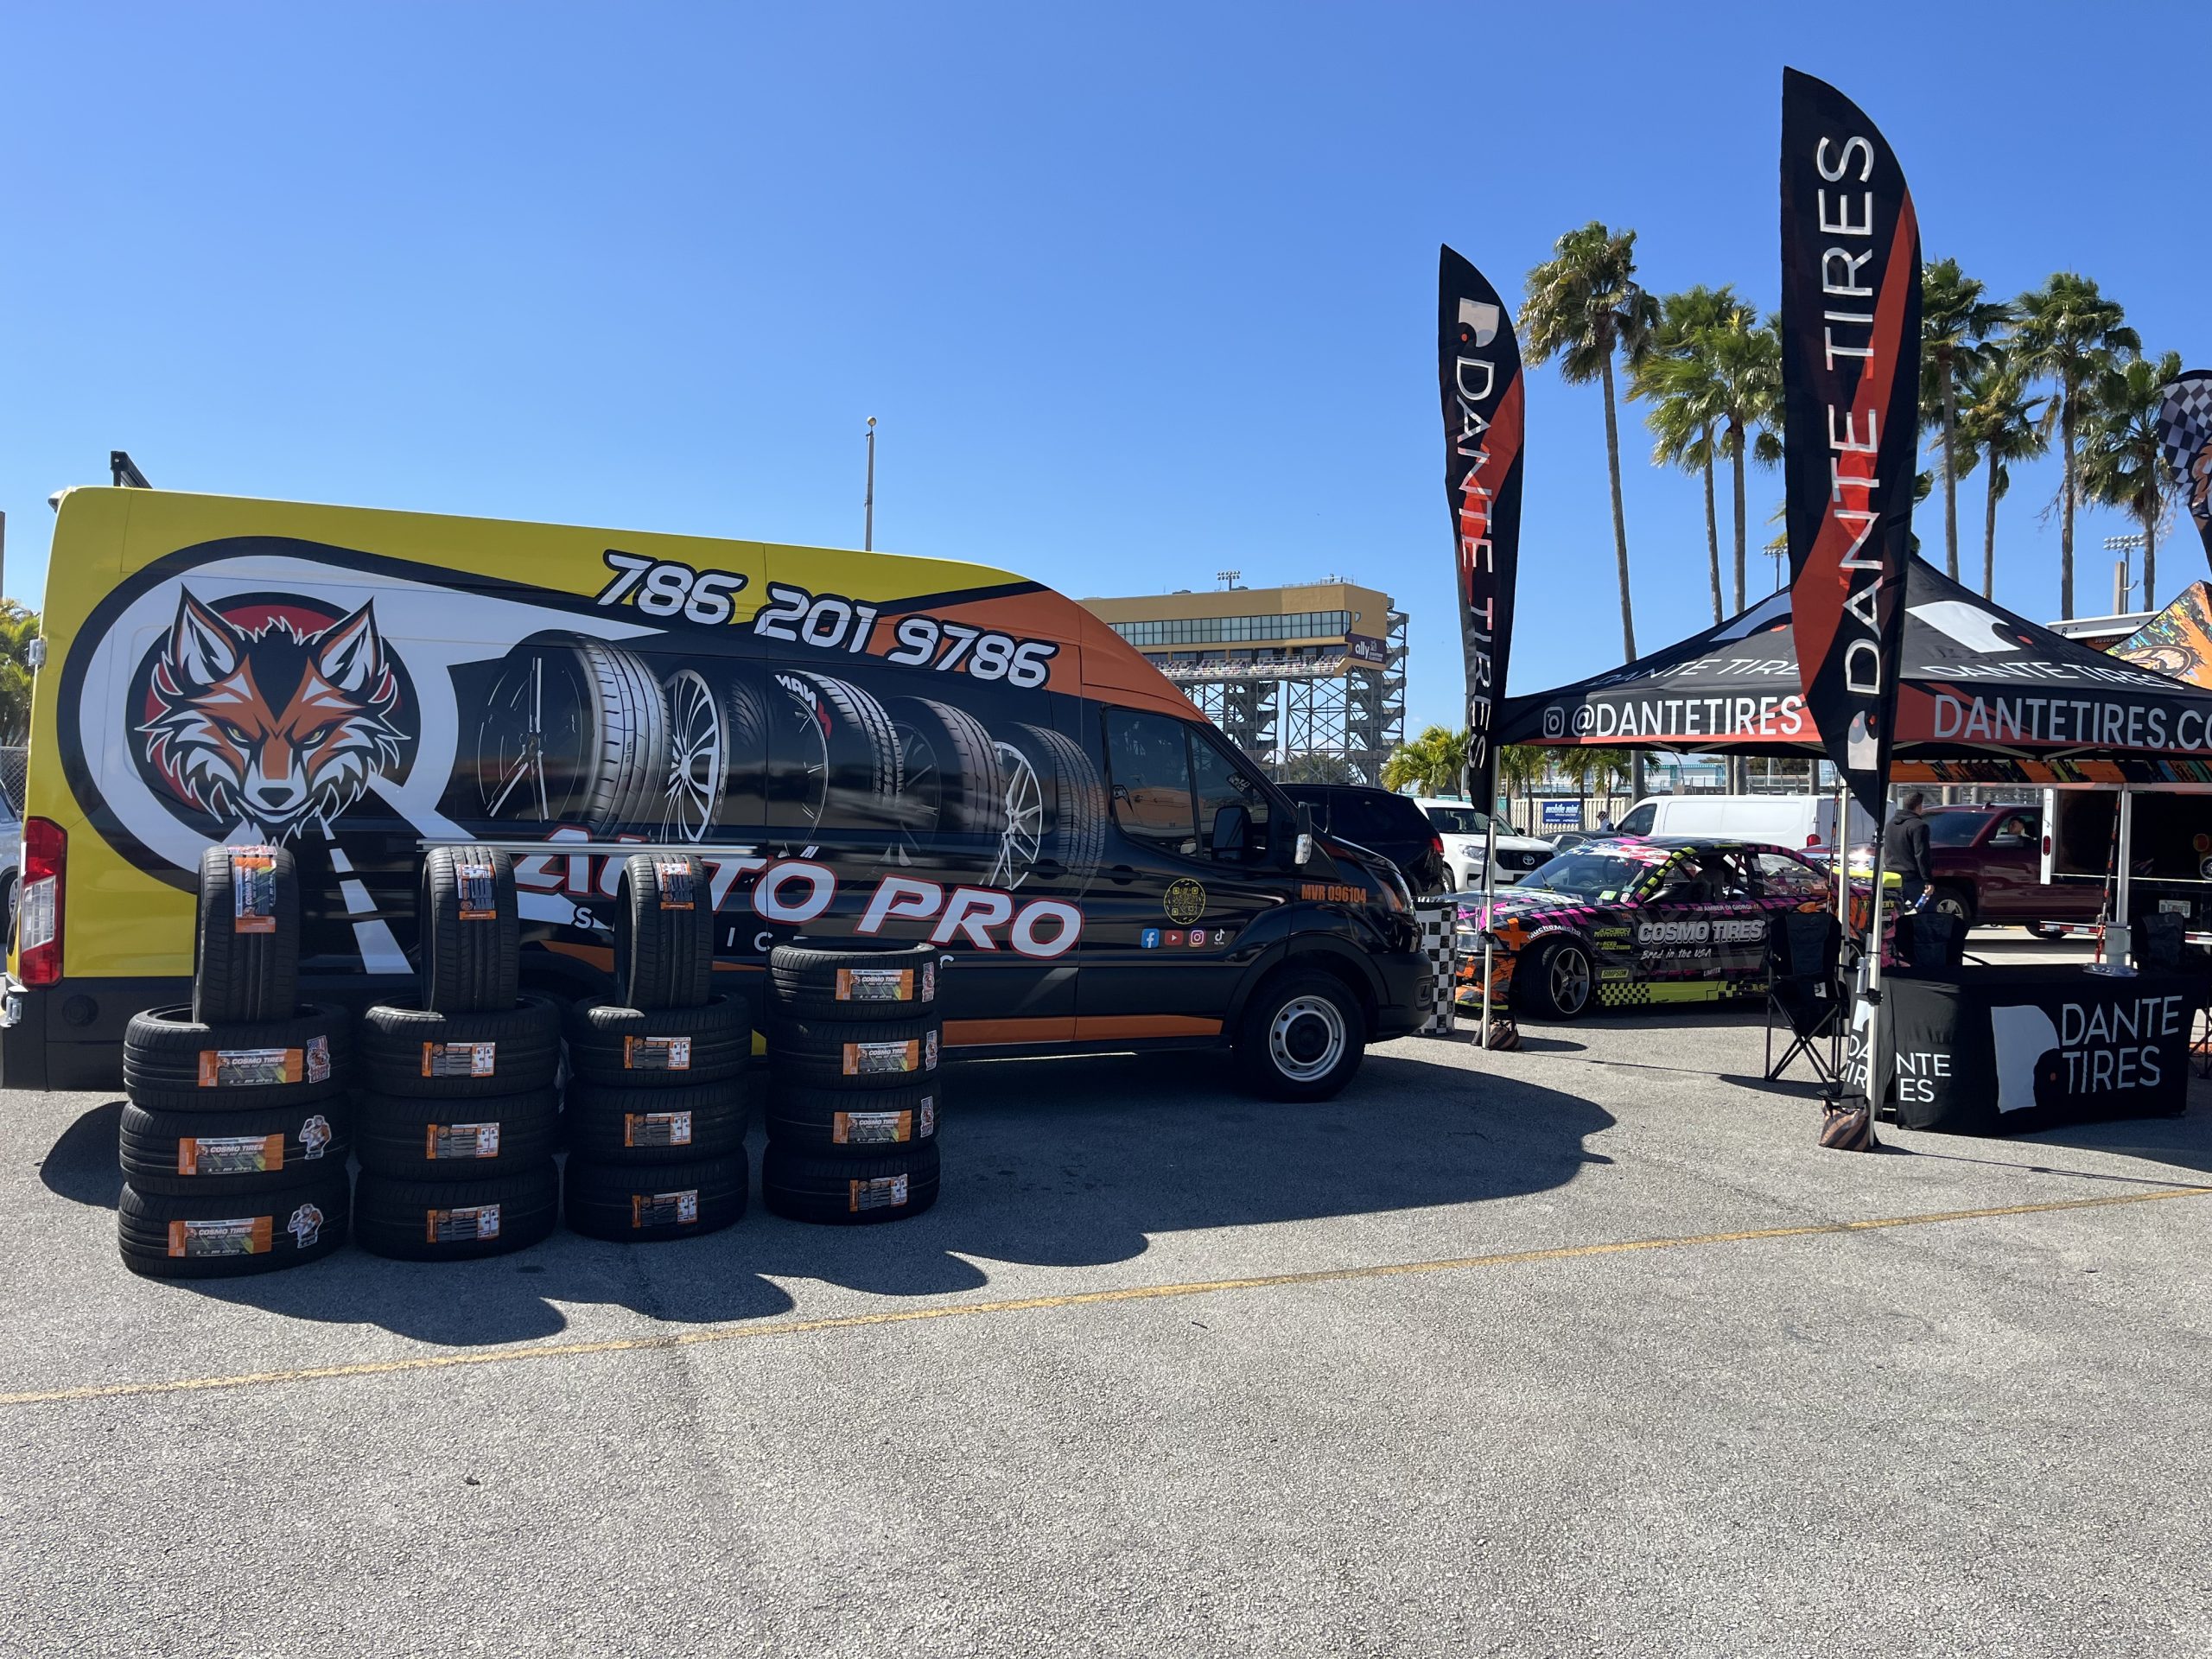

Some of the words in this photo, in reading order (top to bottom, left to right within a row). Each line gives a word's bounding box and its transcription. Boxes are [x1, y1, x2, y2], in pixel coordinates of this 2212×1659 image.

[1816, 135, 1874, 374] TIRES
[1457, 355, 1495, 573] DANTE
[1827, 404, 1882, 695] DANTE
[597, 552, 747, 626] 786
[754, 585, 878, 654] 201
[887, 616, 1058, 690] 9786
[1355, 640, 1370, 659] ally
[1585, 658, 1722, 688] DANTE
[1467, 597, 1493, 769] TIRES
[1920, 662, 2079, 680] DANTE
[2061, 662, 2184, 690] TIRES
[1571, 695, 1802, 738] @DANTETIRES
[1934, 694, 2212, 751] DANTETIRES.C
[853, 874, 1084, 960] PRO
[1302, 884, 1326, 900] MVR
[1328, 886, 1367, 903] 096104
[1638, 921, 1710, 944] COSMO
[1712, 919, 1764, 943] TIRES
[1640, 949, 1664, 960] Bred
[1666, 950, 1675, 959] in
[1678, 949, 1690, 959] the
[1694, 948, 1712, 957] USA
[2062, 995, 2183, 1046] DANTE
[2061, 1045, 2161, 1095] TIRES
